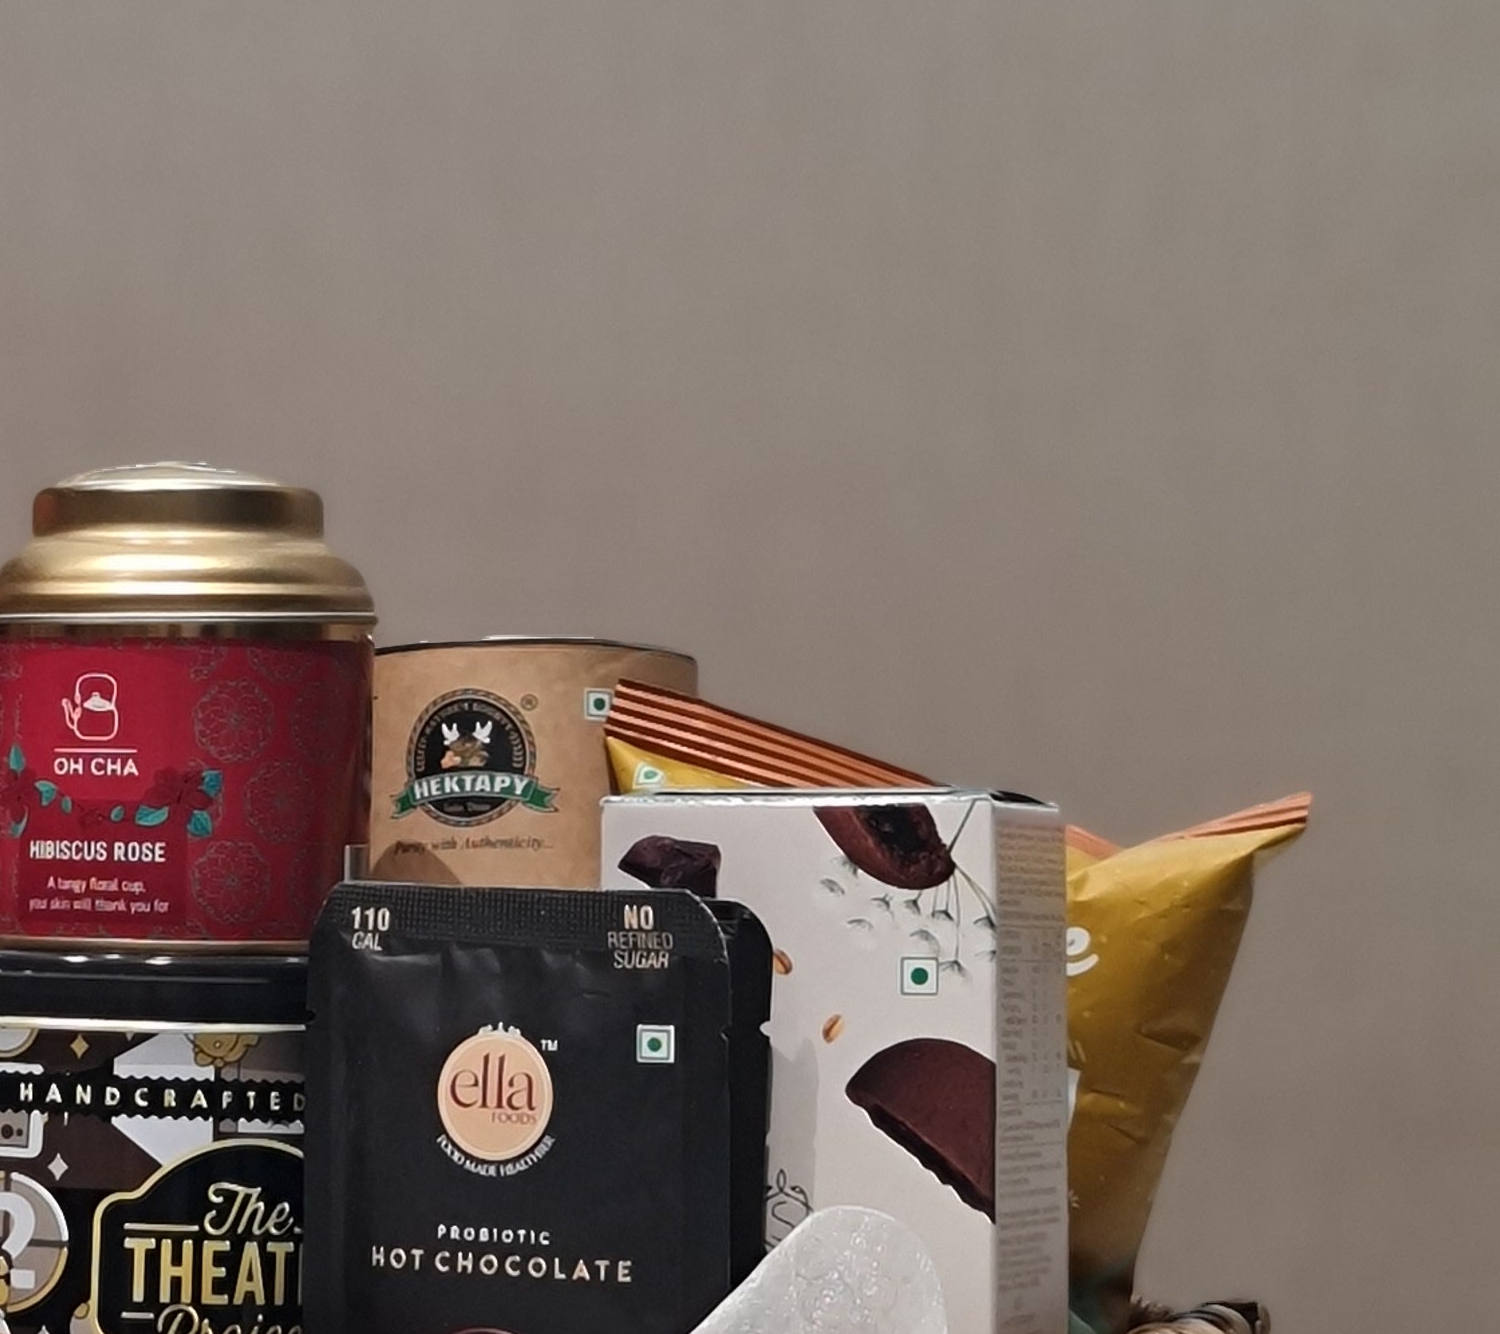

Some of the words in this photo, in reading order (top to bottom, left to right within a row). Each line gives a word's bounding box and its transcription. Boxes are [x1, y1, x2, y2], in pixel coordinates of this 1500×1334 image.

[54, 757, 83, 775] OH
[90, 758, 139, 776] CHA
[413, 773, 529, 800] HEKTAPY
[29, 840, 107, 861] HIBISCUS
[114, 842, 166, 862] ROSE
[431, 836, 457, 850] with
[47, 876, 56, 889] A
[58, 877, 86, 893] tangy
[89, 877, 118, 891] floral
[95, 898, 126, 912] thank
[130, 901, 150, 914] you
[153, 898, 169, 912] for
[623, 904, 654, 930] NO
[351, 906, 390, 931] 110
[607, 931, 673, 949] REFINED
[613, 950, 669, 969] SUGAR
[450, 1052, 536, 1111] ella
[19, 1082, 306, 1111] HANDCRAFTED
[491, 1112, 537, 1125] FOODS
[204, 1182, 294, 1235] The
[437, 1223, 551, 1245] PROBIOTIC
[124, 1237, 303, 1306] THEAT
[372, 1245, 425, 1271] HOT
[434, 1250, 632, 1283] CHOCOLATE
